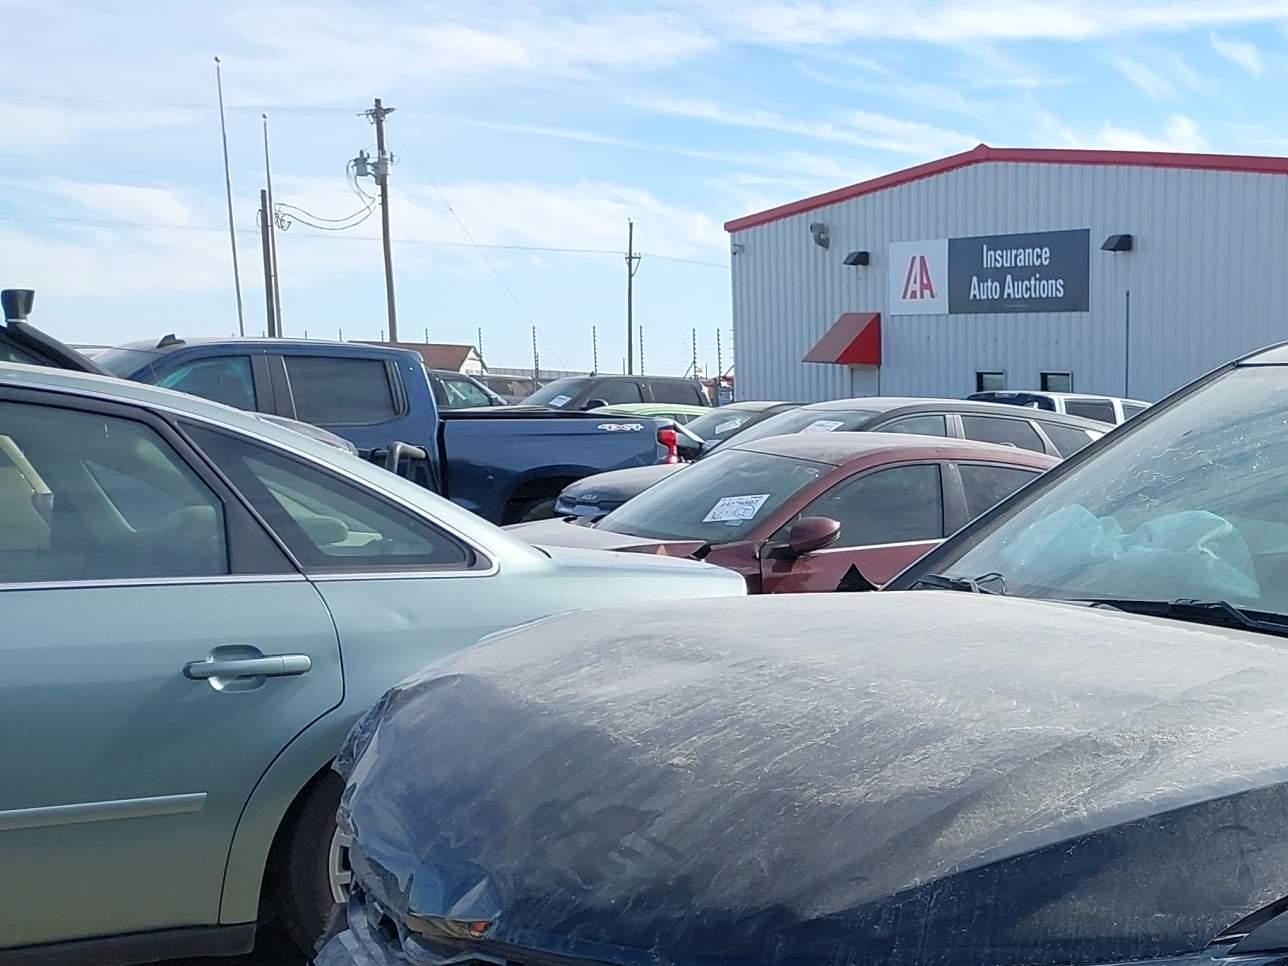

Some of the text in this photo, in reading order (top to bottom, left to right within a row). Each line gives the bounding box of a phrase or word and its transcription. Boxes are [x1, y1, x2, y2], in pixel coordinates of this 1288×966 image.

[982, 244, 1050, 269] Insurance
[969, 273, 1065, 300] Auto Auctions
